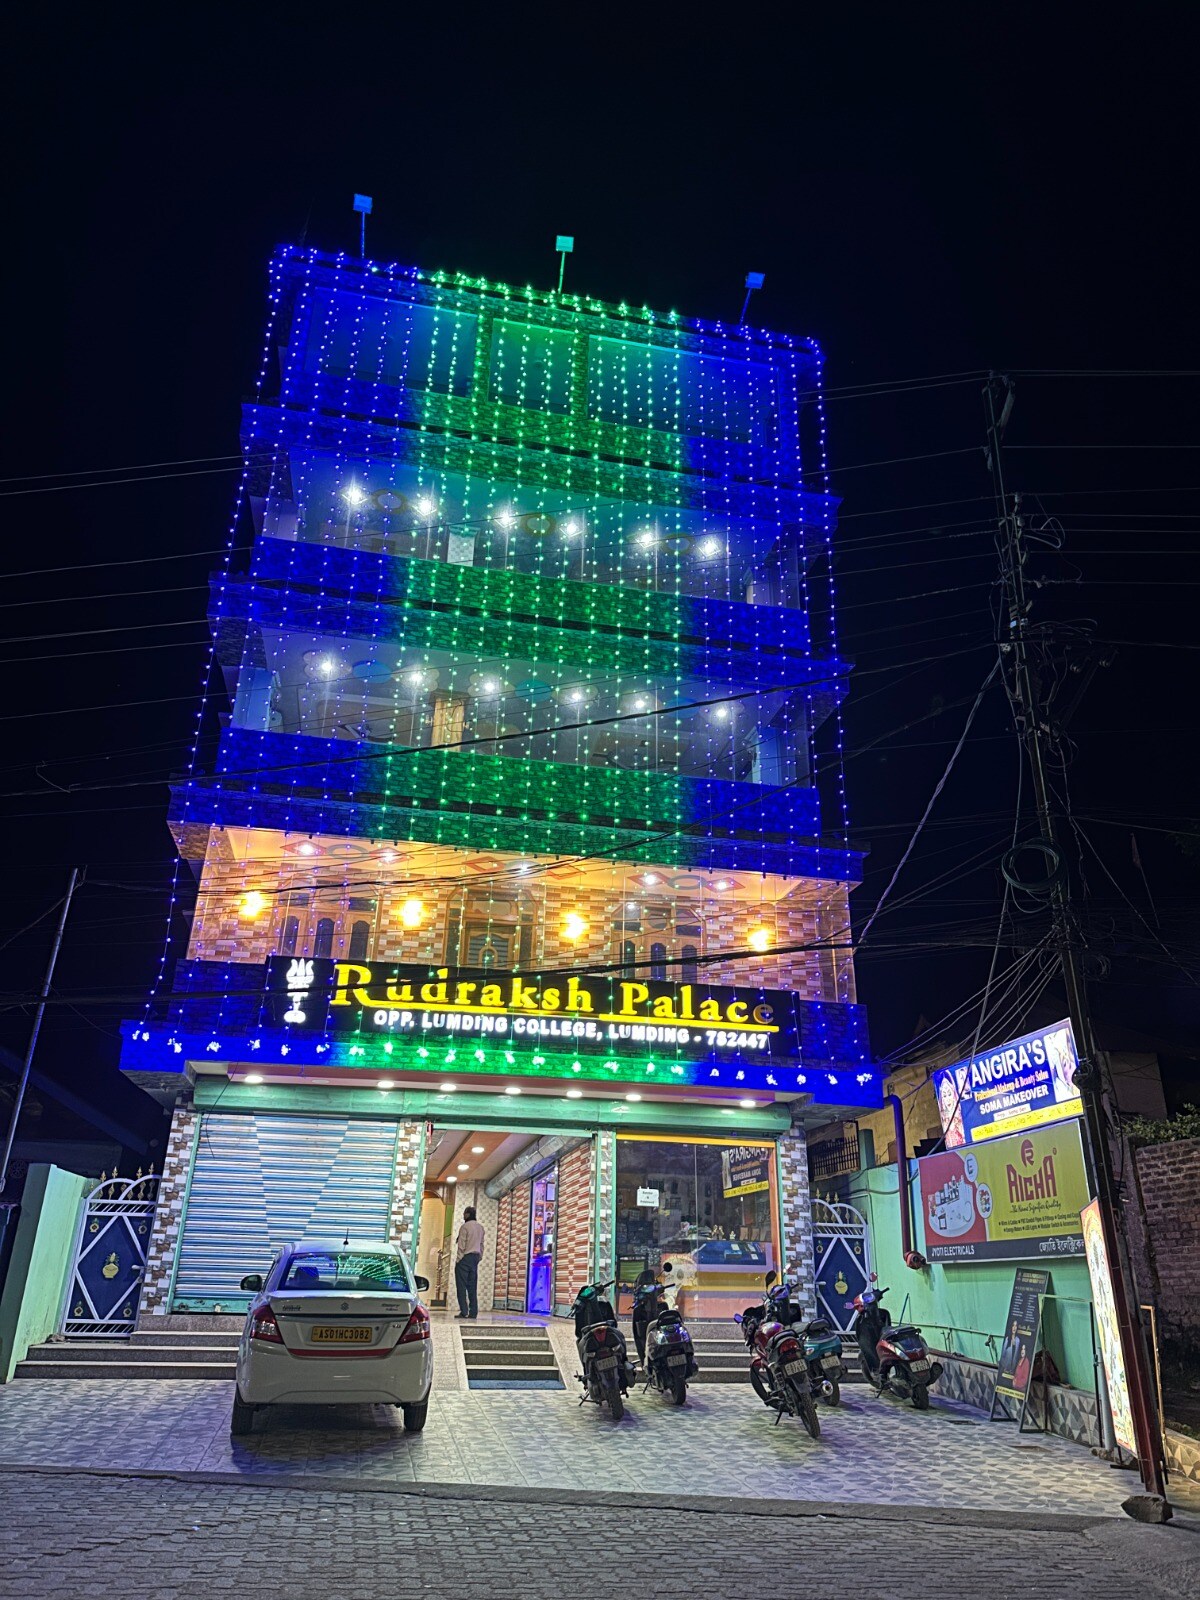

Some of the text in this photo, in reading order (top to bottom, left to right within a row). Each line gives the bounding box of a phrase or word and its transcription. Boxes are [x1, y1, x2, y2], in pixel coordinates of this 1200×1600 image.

[329, 963, 774, 1024] Rudraksh Palace
[373, 1009, 415, 1027] OPP.
[421, 1013, 508, 1033] LUMDING
[513, 1018, 603, 1041] COLLEGE,
[608, 1024, 690, 1043] LUMDING
[705, 1030, 768, 1050] 782447
[971, 1038, 1046, 1087] ANGIRA'S
[1020, 1074, 1036, 1087] Beauty
[1036, 1069, 1049, 1082] Salon
[979, 1085, 1049, 1115] SOMA MAKEOVER
[943, 1245, 975, 1256] ELECTRICALS
[318, 1329, 369, 1340] AS01HC3082
